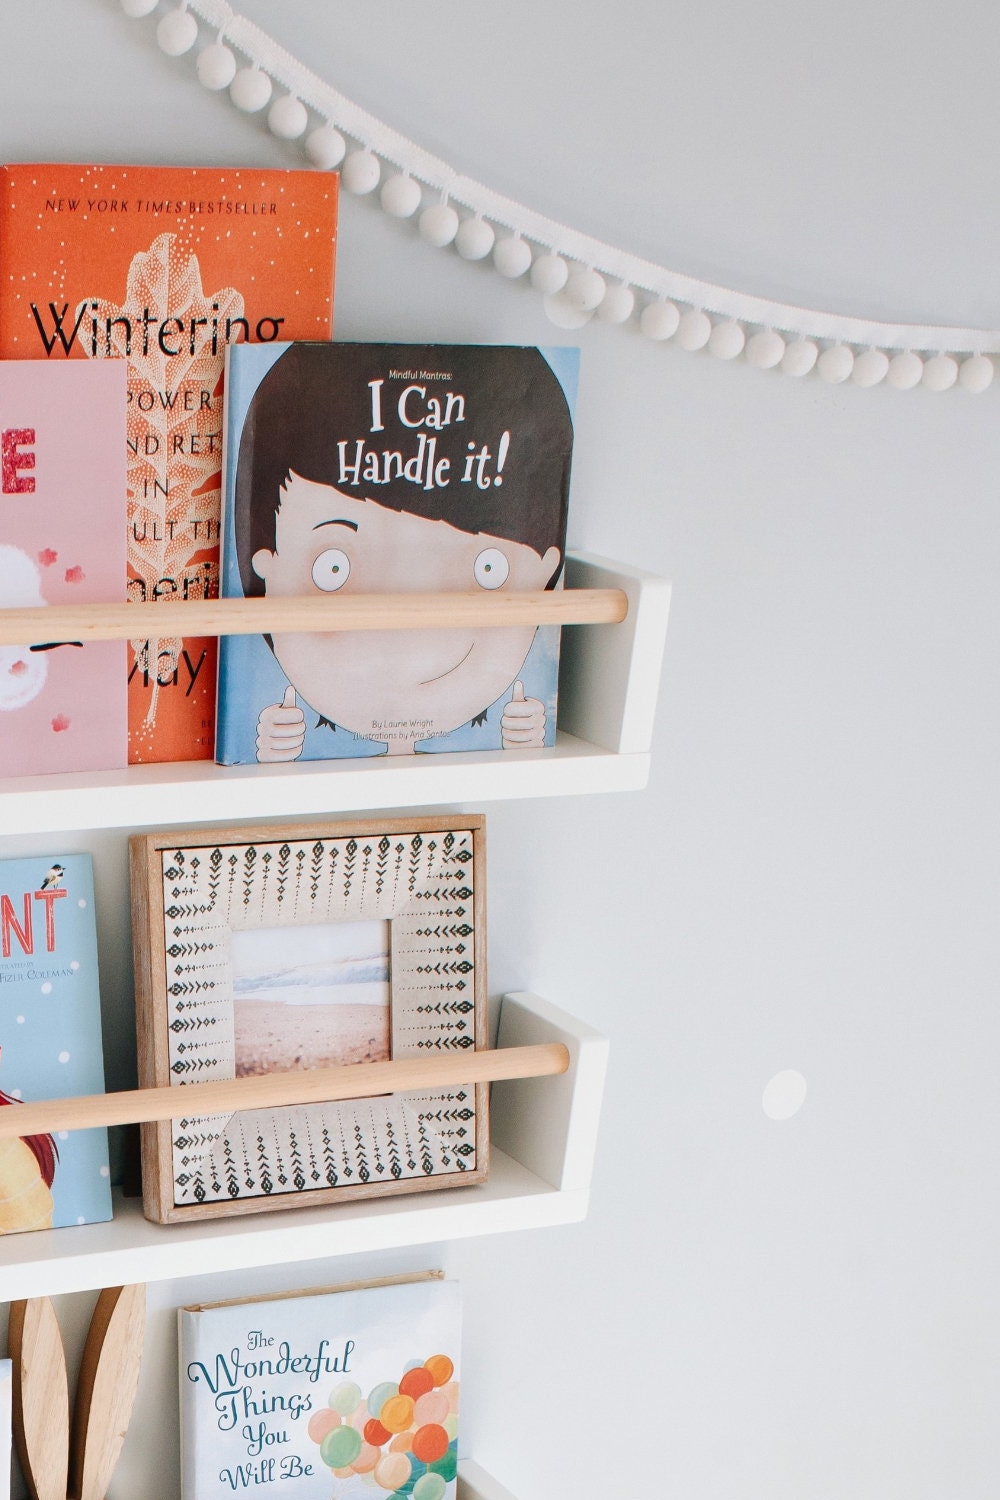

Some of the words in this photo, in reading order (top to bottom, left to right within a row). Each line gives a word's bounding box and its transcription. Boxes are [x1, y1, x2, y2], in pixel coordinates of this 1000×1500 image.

[46, 200, 81, 212] NEW
[87, 200, 129, 213] YORK
[137, 200, 183, 214] TIMES
[190, 202, 278, 216] BESTSELLER
[388, 369, 418, 380] Mindful
[367, 379, 386, 433] I
[397, 385, 466, 431] Can
[336, 433, 451, 492] Handle
[461, 430, 511, 491] it!
[144, 479, 169, 499] IN
[372, 720, 383, 730] By
[384, 719, 408, 728] Laurie
[409, 719, 434, 730] Wright
[399, 732, 408, 741] by
[410, 730, 425, 739] Ana
[247, 1330, 275, 1351] The
[187, 1340, 355, 1394] Wonderful
[215, 1385, 313, 1431] Things
[242, 1421, 291, 1457] You
[219, 1458, 276, 1491] Will
[279, 1455, 316, 1480] Be
